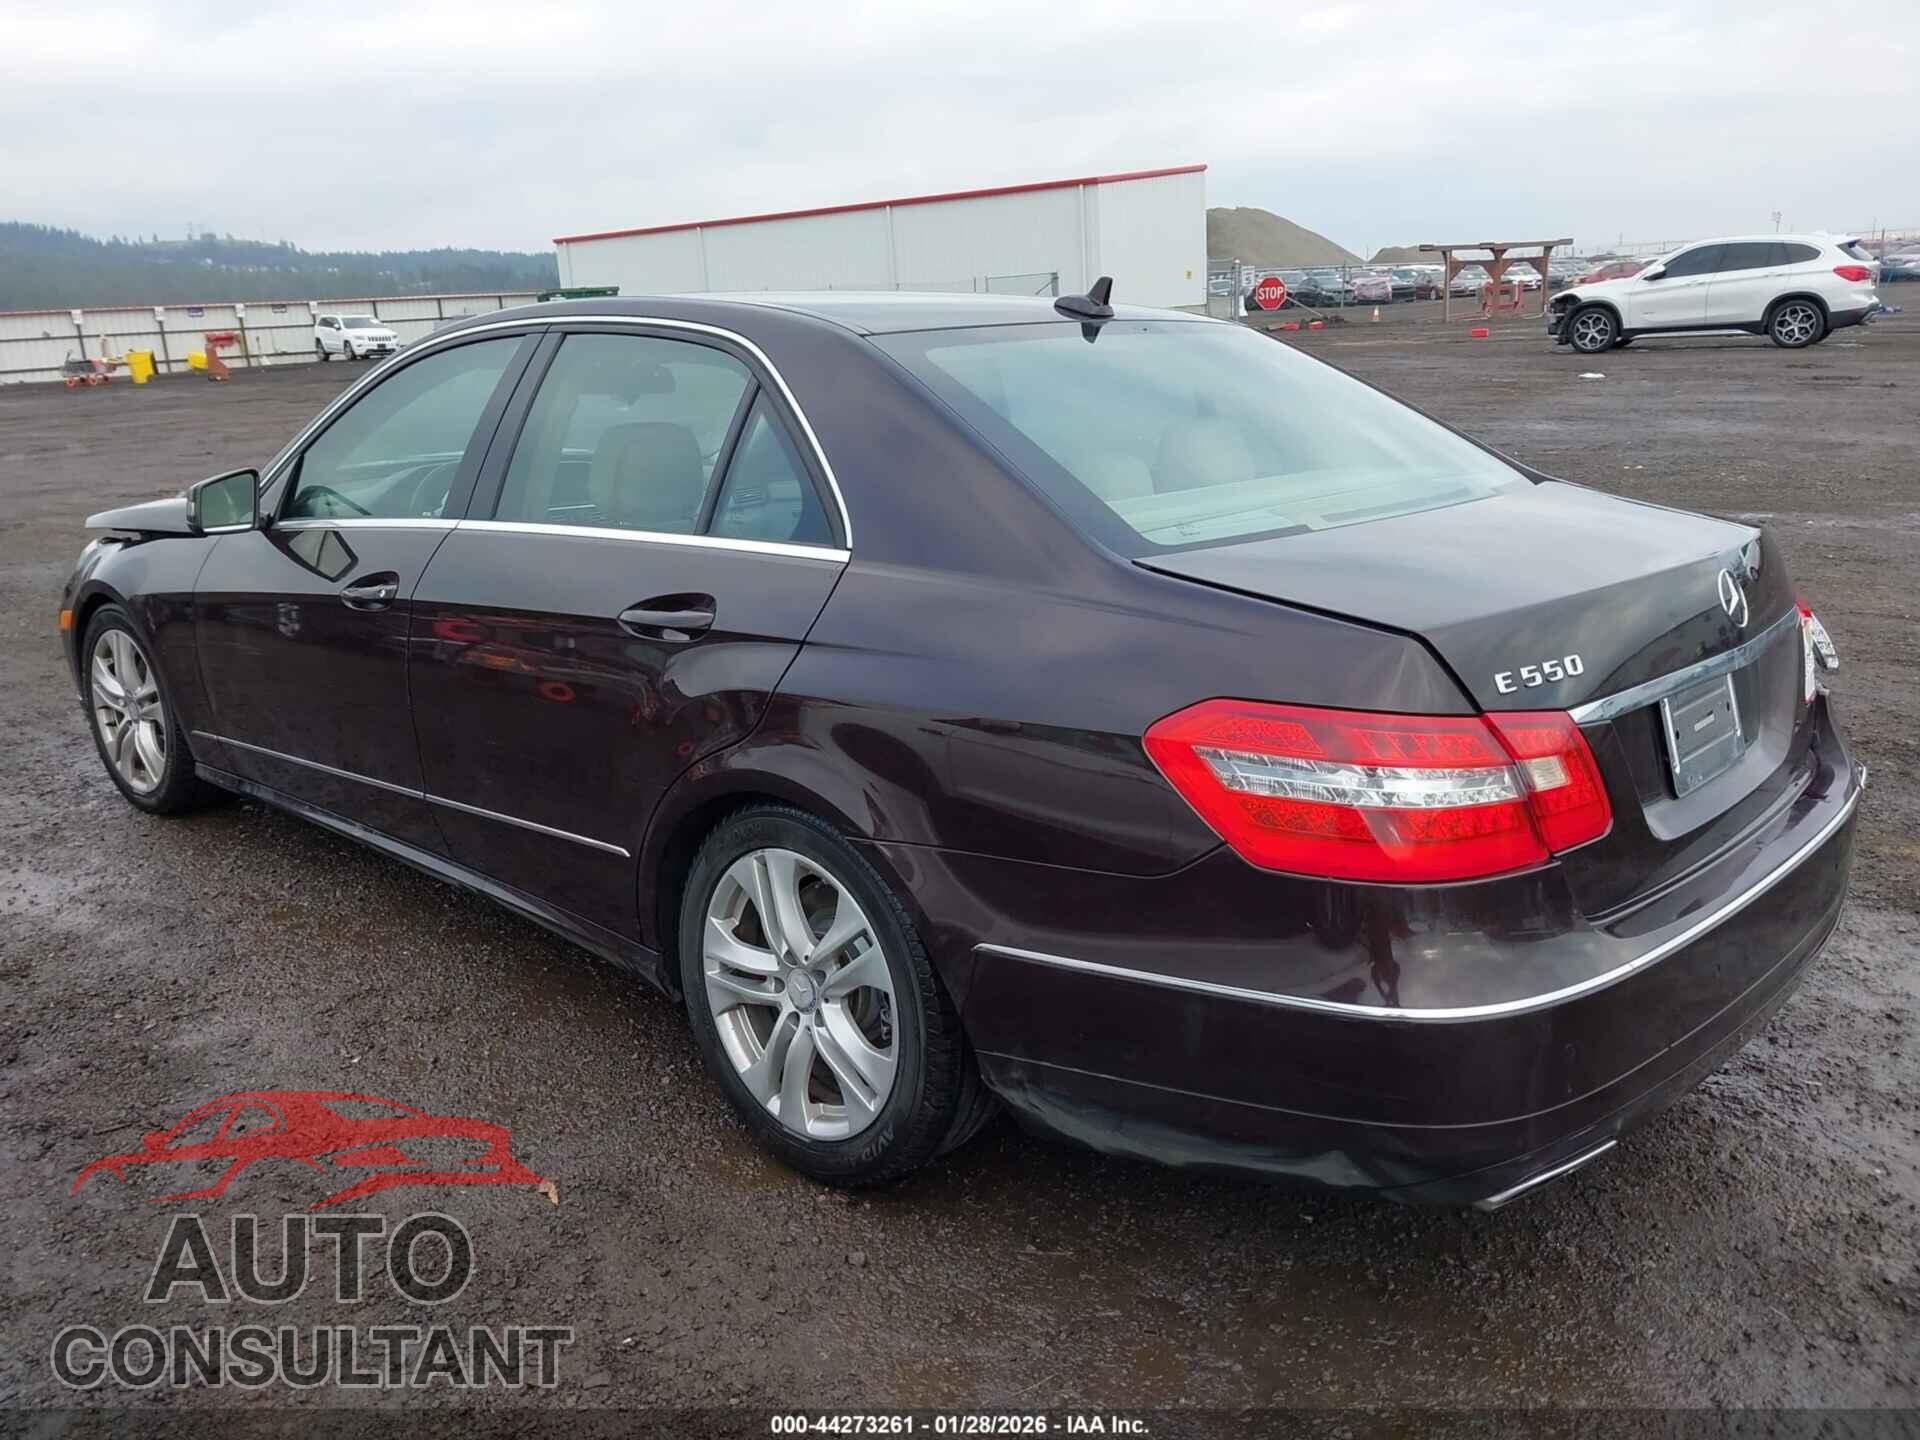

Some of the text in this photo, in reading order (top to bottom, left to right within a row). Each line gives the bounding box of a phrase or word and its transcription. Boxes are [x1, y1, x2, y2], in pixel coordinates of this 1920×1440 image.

[1258, 286, 1284, 301] STOP
[1494, 654, 1585, 694] E 550
